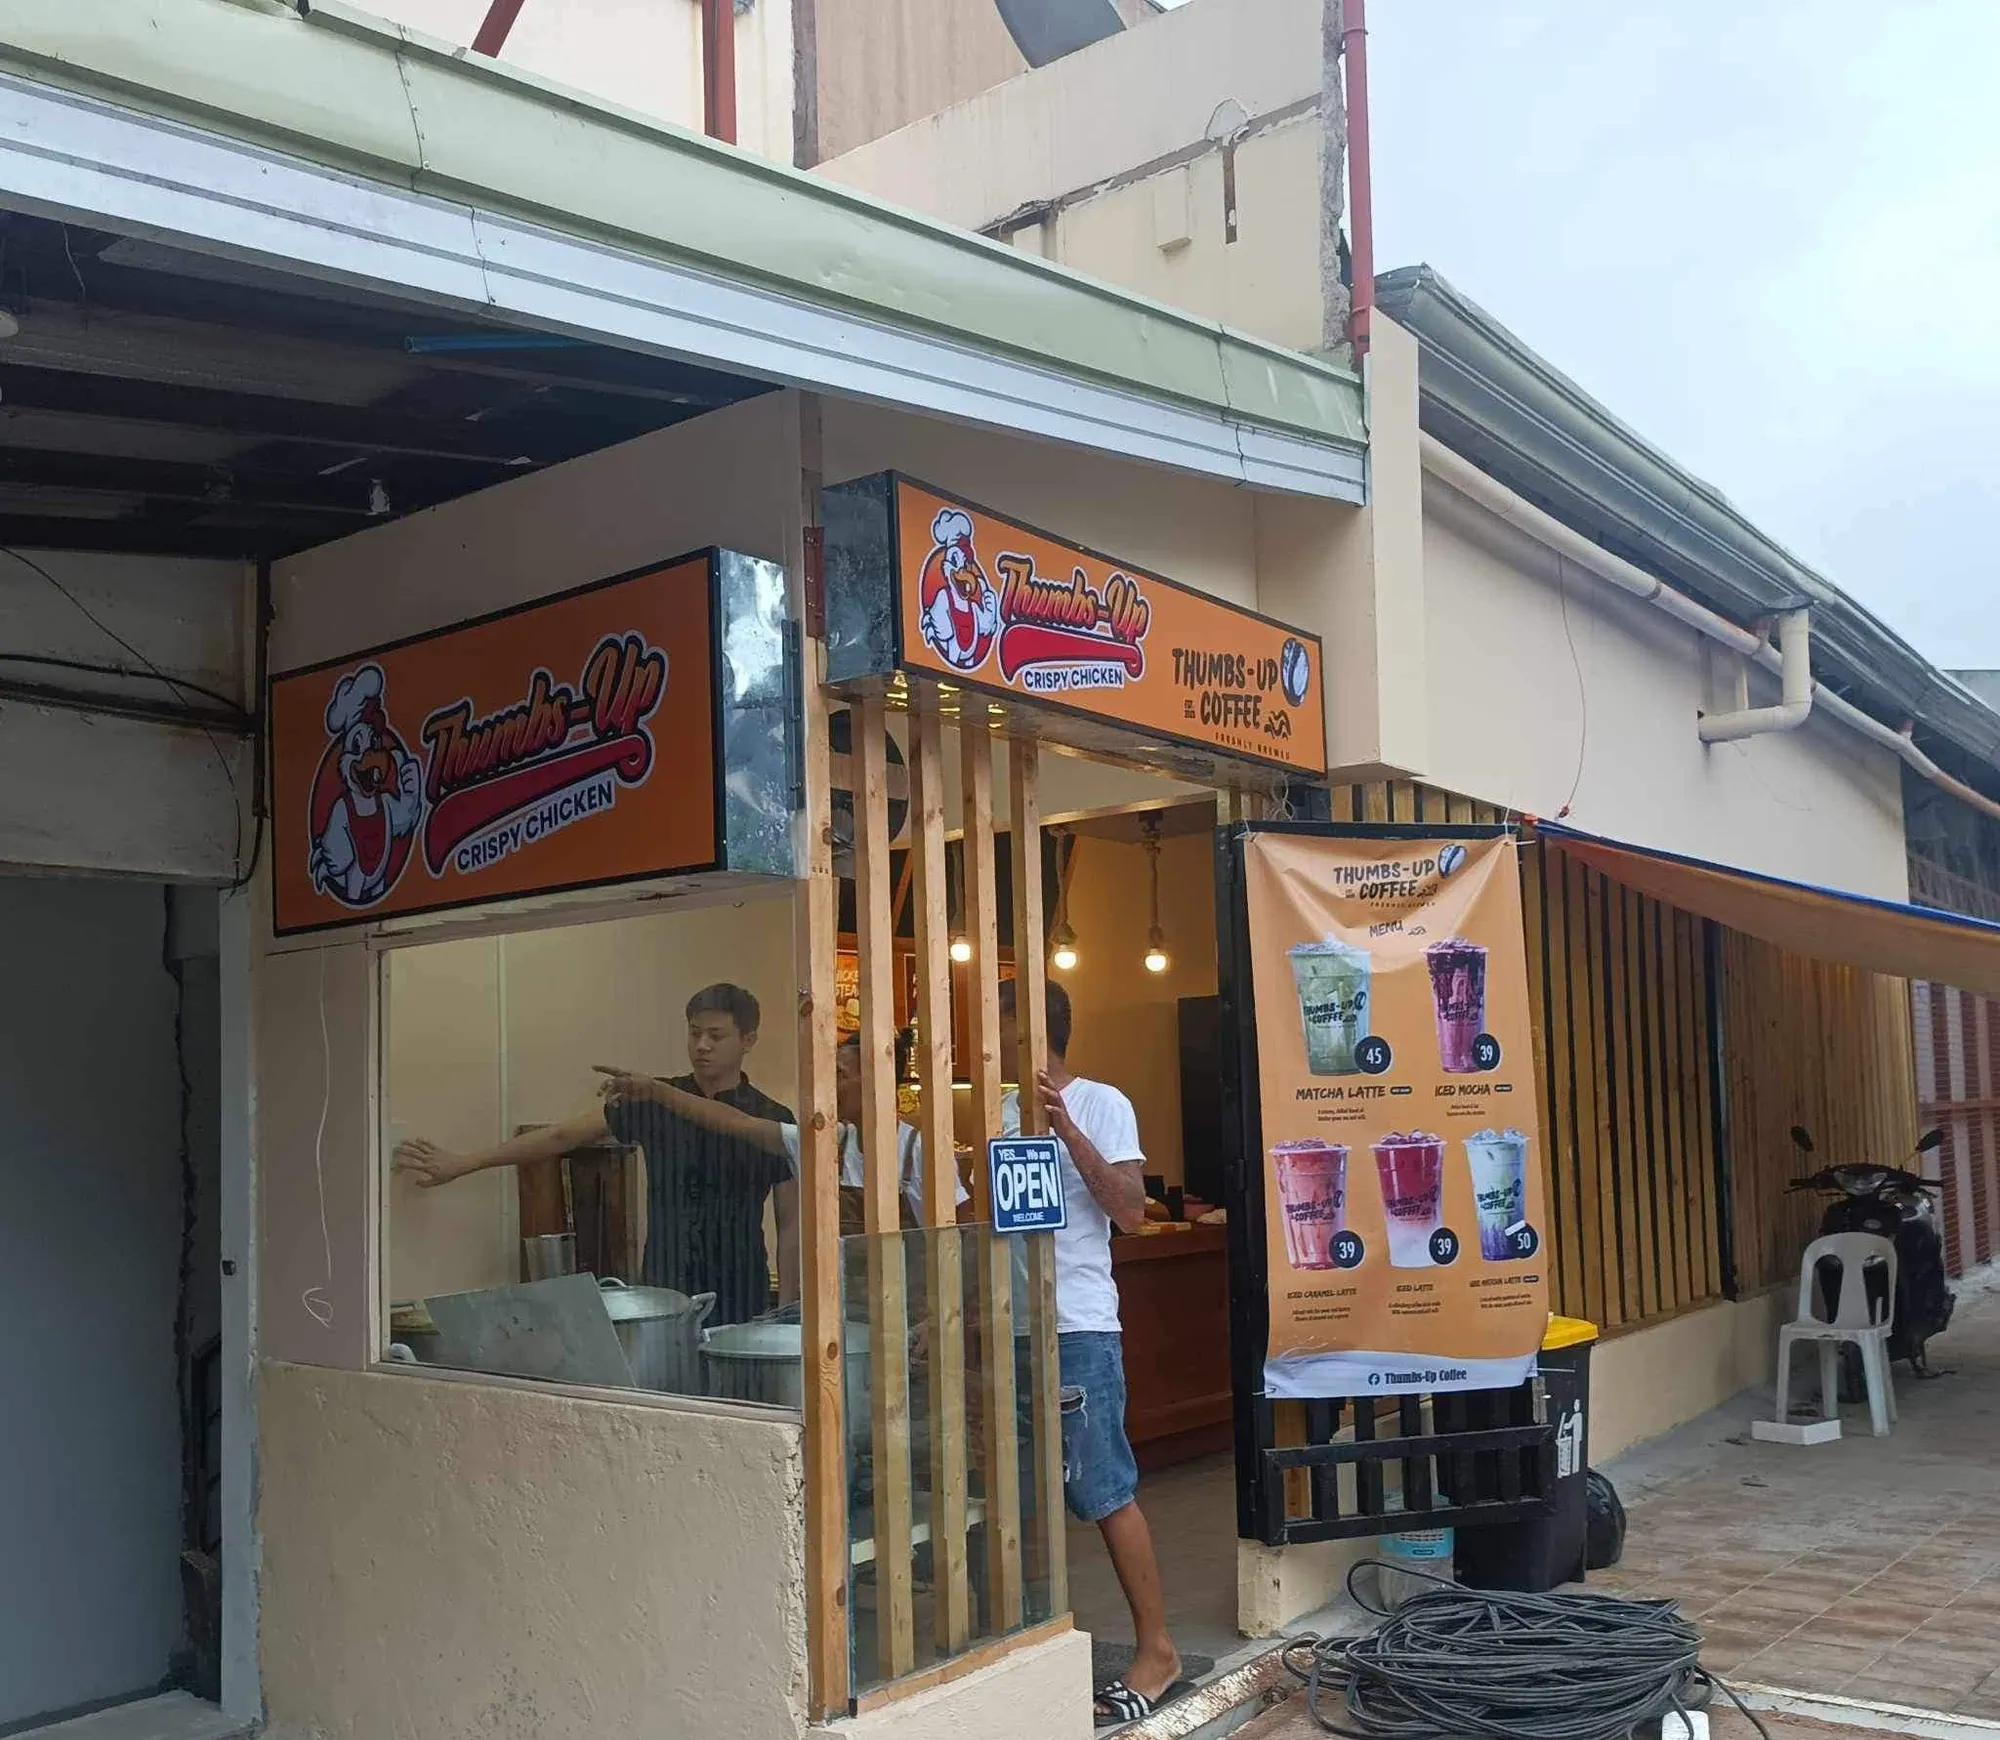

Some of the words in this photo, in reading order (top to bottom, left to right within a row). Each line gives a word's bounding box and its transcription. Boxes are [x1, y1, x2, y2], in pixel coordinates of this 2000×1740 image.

[998, 553, 1150, 645] Thumbs-Up
[1024, 670, 1069, 690] CRISPY
[1071, 667, 1123, 687] CHICKEN
[1171, 647, 1279, 692] THUMBS-UP
[422, 634, 667, 803] Thumbs-Up
[1200, 690, 1262, 729] COFFEE
[1215, 731, 1253, 750] FRESHLY
[457, 823, 521, 871] CRISPY
[526, 779, 614, 839] CHICKEN
[1333, 859, 1436, 884] THUMBS-UP
[1359, 880, 1418, 900] COFFEE
[1369, 920, 1404, 938] MENU
[1312, 1011, 1343, 1025] COFFEE
[1366, 1048, 1382, 1065] 45
[1480, 1045, 1493, 1062] 39
[1295, 1086, 1344, 1100] MATCHA
[1348, 1085, 1386, 1099] LATTE
[1434, 1085, 1456, 1097] ICED
[1458, 1083, 1491, 1096] MOCHA
[997, 1162, 1059, 1211] OPEN
[1012, 1211, 1044, 1222] WELCOME
[1339, 1241, 1356, 1259] 39
[1437, 1237, 1452, 1256] 39
[1517, 1232, 1531, 1250] 50
[1287, 1290, 1303, 1299] ICED
[1304, 1289, 1335, 1299] CARAMEL
[1337, 1287, 1357, 1297] LATTE
[1396, 1283, 1413, 1292] ICED
[1413, 1283, 1434, 1293] LATTE
[1384, 1370, 1437, 1384] Thumbs-Up
[1440, 1369, 1467, 1381] Coffee
